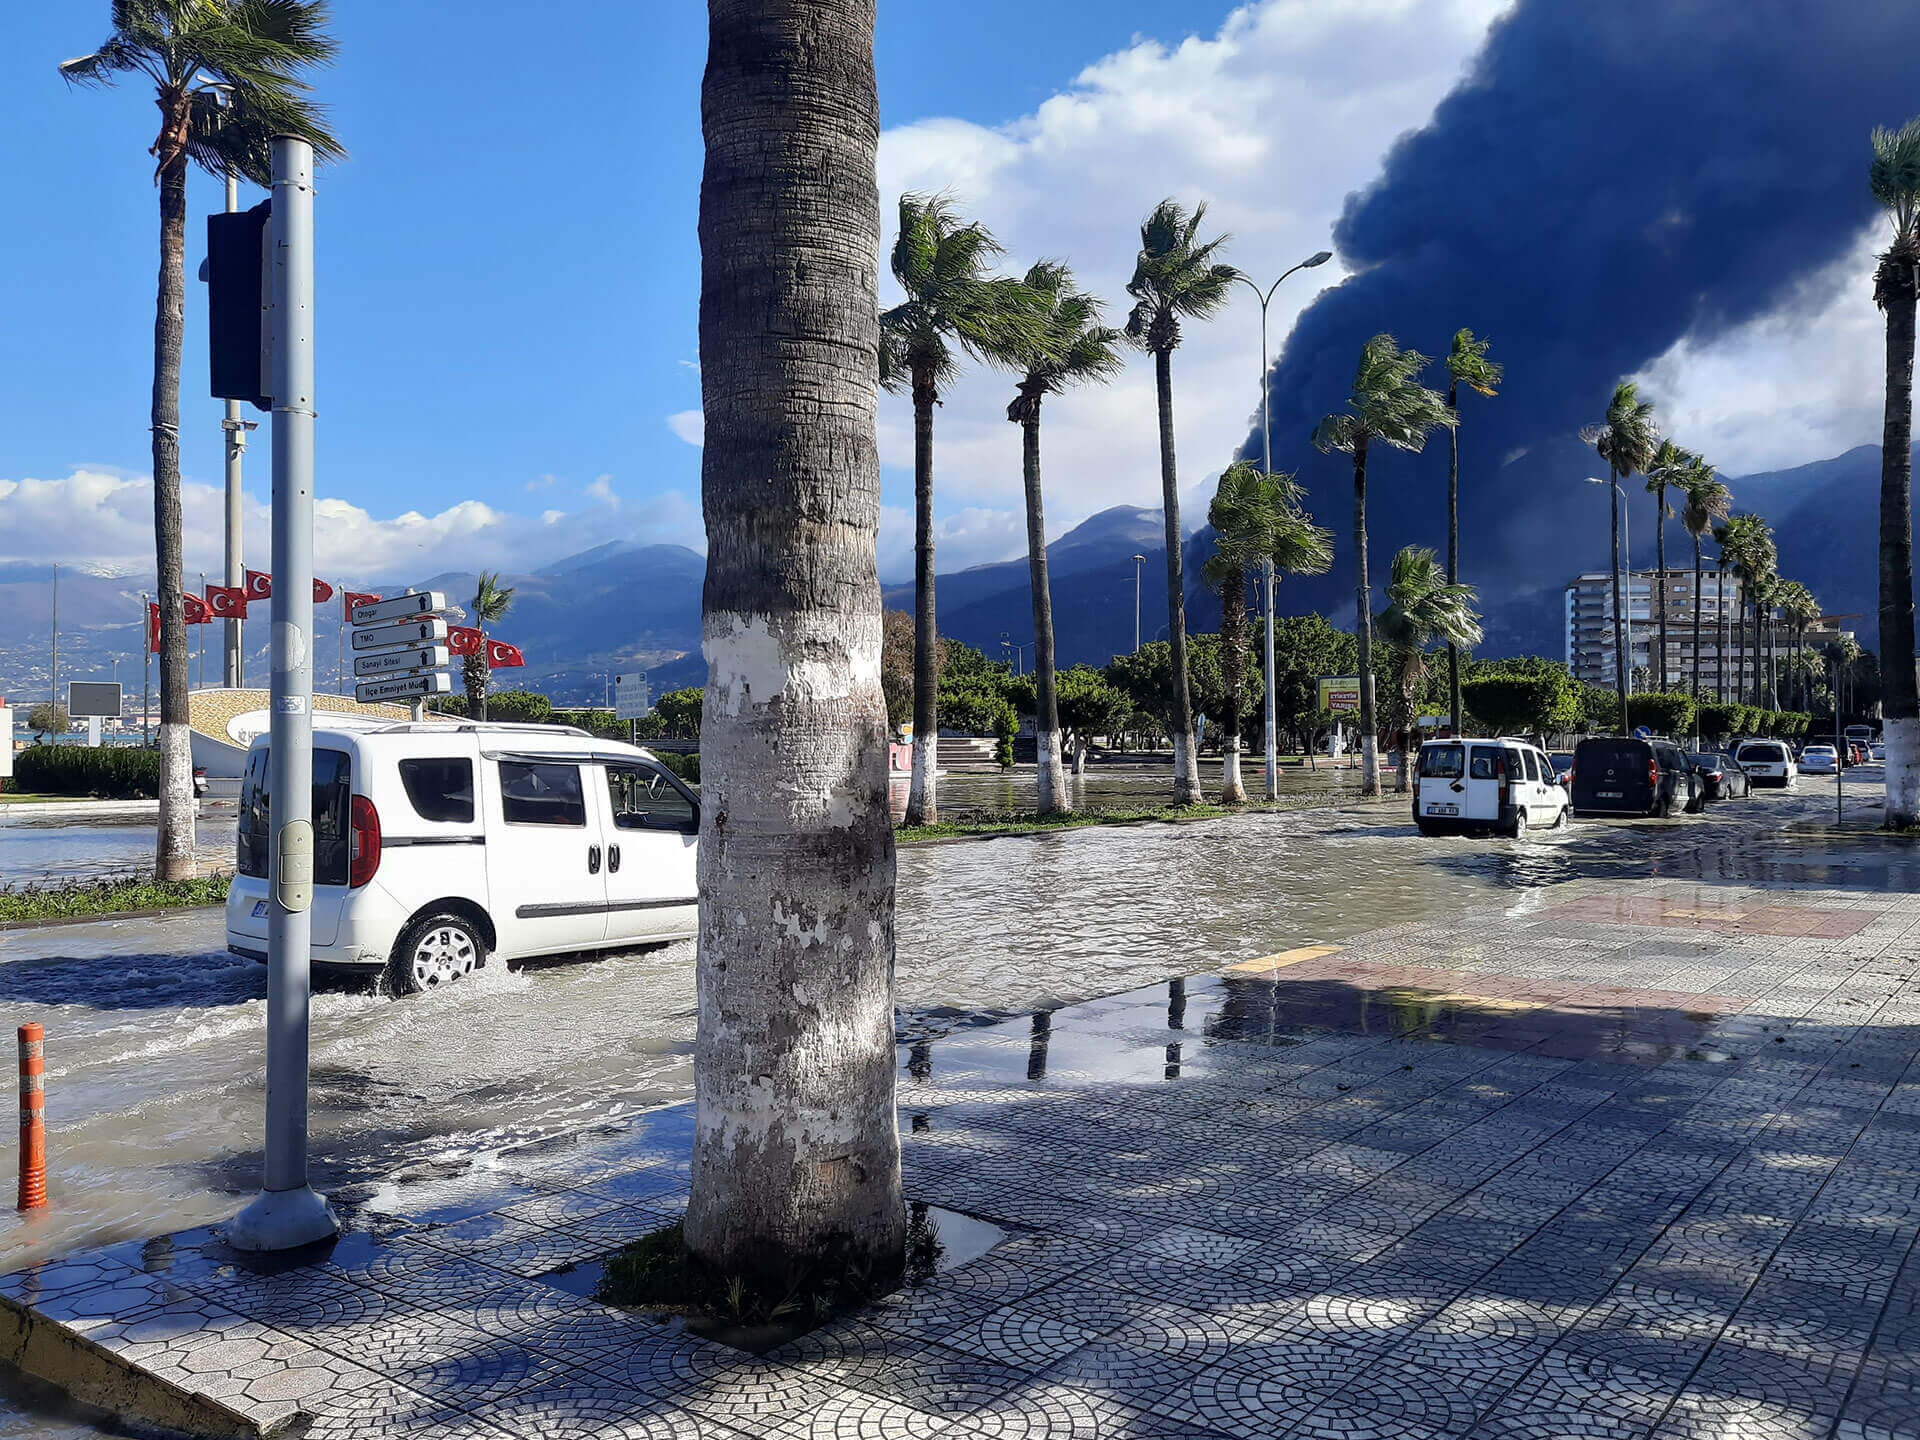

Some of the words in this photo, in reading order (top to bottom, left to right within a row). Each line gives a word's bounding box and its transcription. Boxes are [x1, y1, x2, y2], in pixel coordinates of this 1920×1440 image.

[360, 634, 374, 642] TMO
[361, 661, 382, 669] Sanayi
[384, 657, 400, 666] Sitesi
[379, 682, 407, 694] Emniyet
